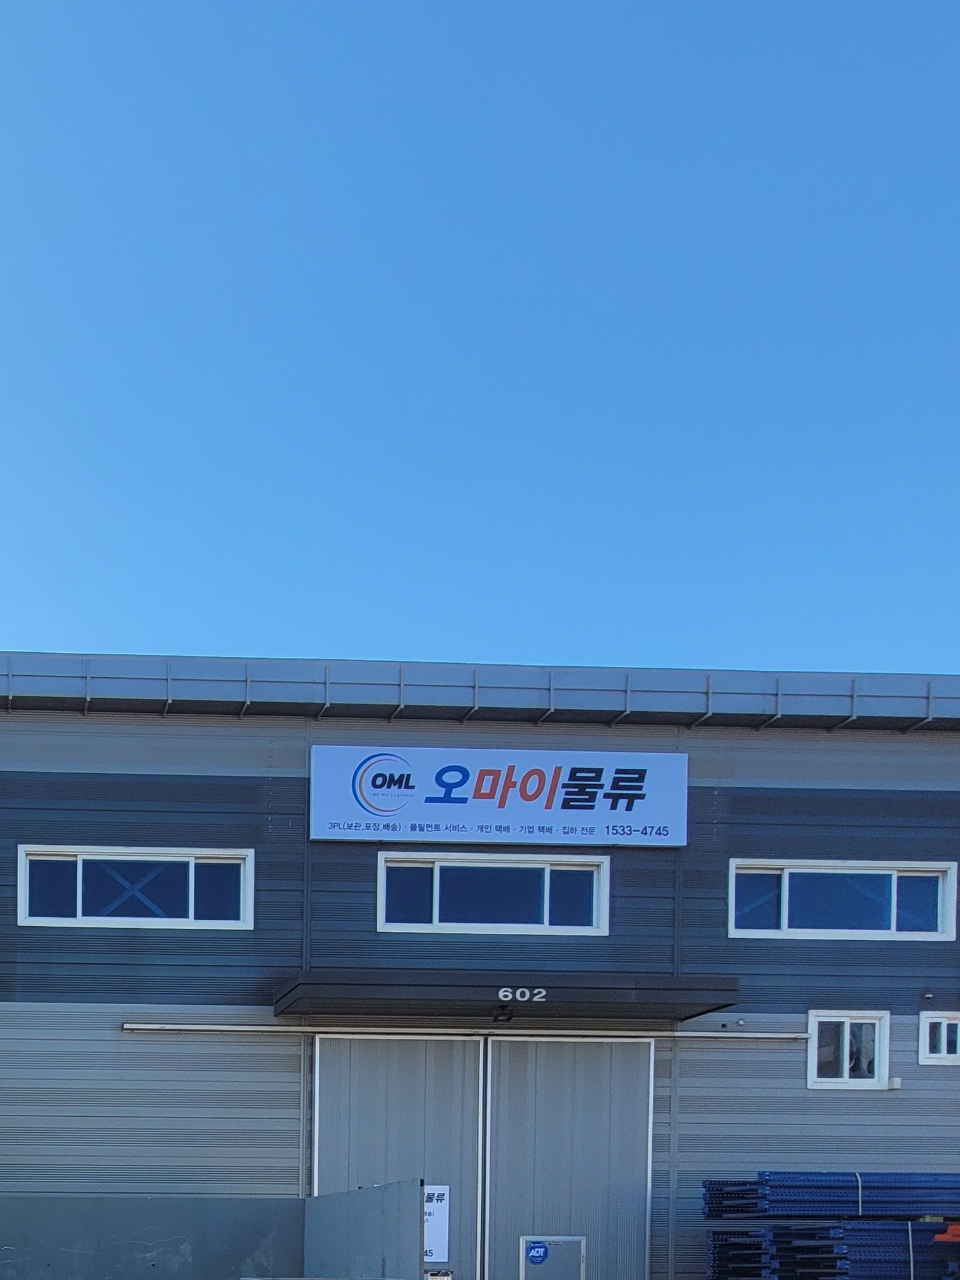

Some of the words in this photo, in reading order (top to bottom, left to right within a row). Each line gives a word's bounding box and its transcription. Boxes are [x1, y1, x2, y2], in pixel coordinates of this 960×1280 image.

[371, 773, 416, 790] OML
[424, 764, 648, 812] 오마이물류
[444, 824, 468, 833] 서비스
[476, 824, 492, 834] 개인
[495, 824, 511, 834] 택배
[519, 825, 535, 835] 기업
[538, 825, 553, 835] 택배
[562, 826, 577, 835] 집하
[580, 826, 596, 836] 전문
[604, 825, 670, 837] 1533-4745
[498, 987, 547, 1002] 602
[529, 1248, 545, 1257] ADT
